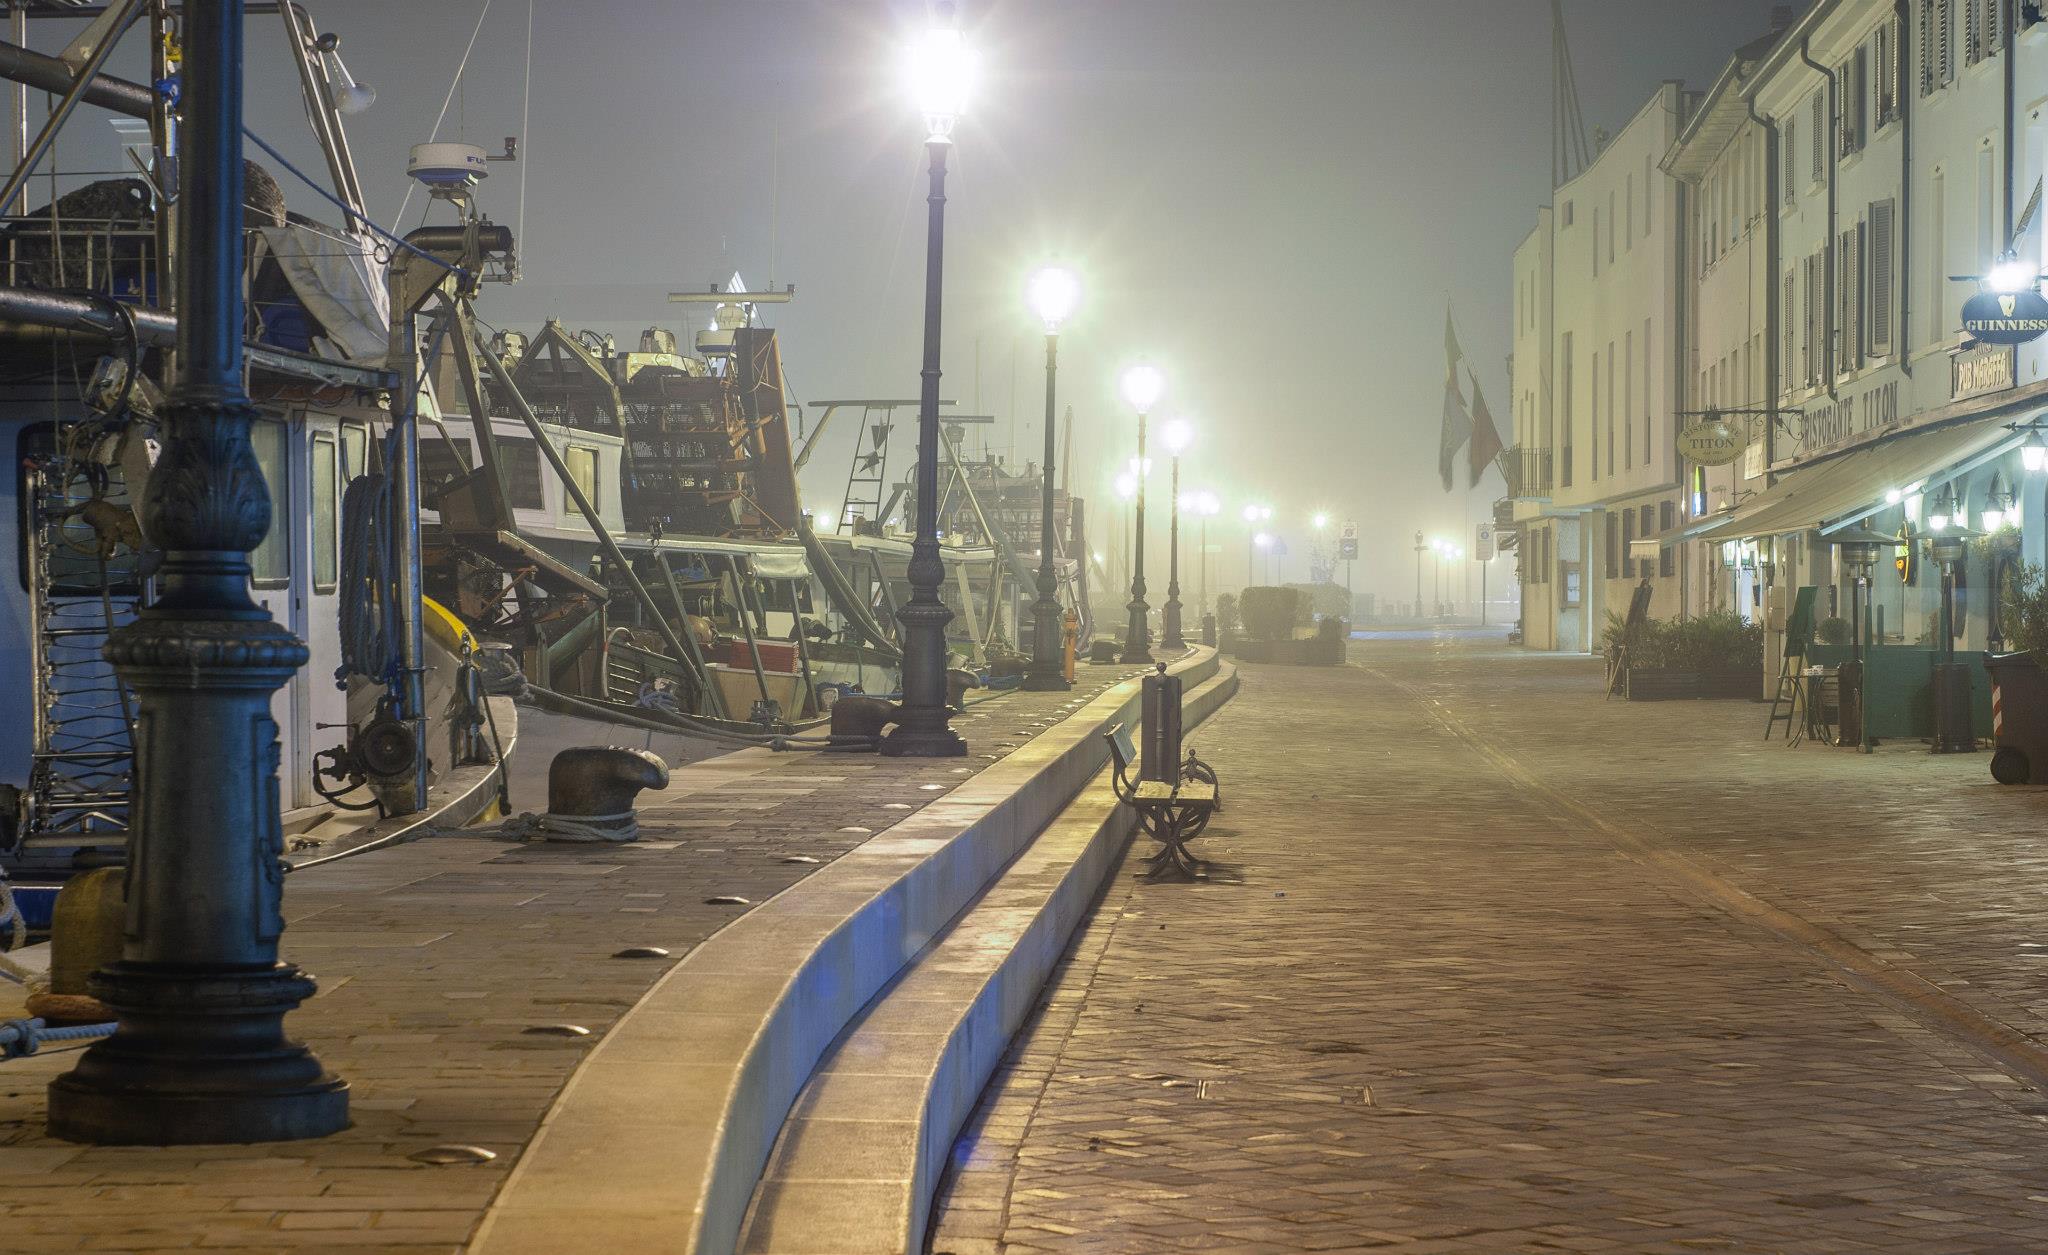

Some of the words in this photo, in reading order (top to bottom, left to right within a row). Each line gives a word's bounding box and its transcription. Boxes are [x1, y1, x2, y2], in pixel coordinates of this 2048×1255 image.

[1966, 319, 2048, 331] GUINNESS
[1959, 362, 1973, 392] PUB
[1804, 395, 1853, 453] RISTORANTE
[1863, 380, 1898, 430] TITON
[1689, 438, 1735, 449] TITON
